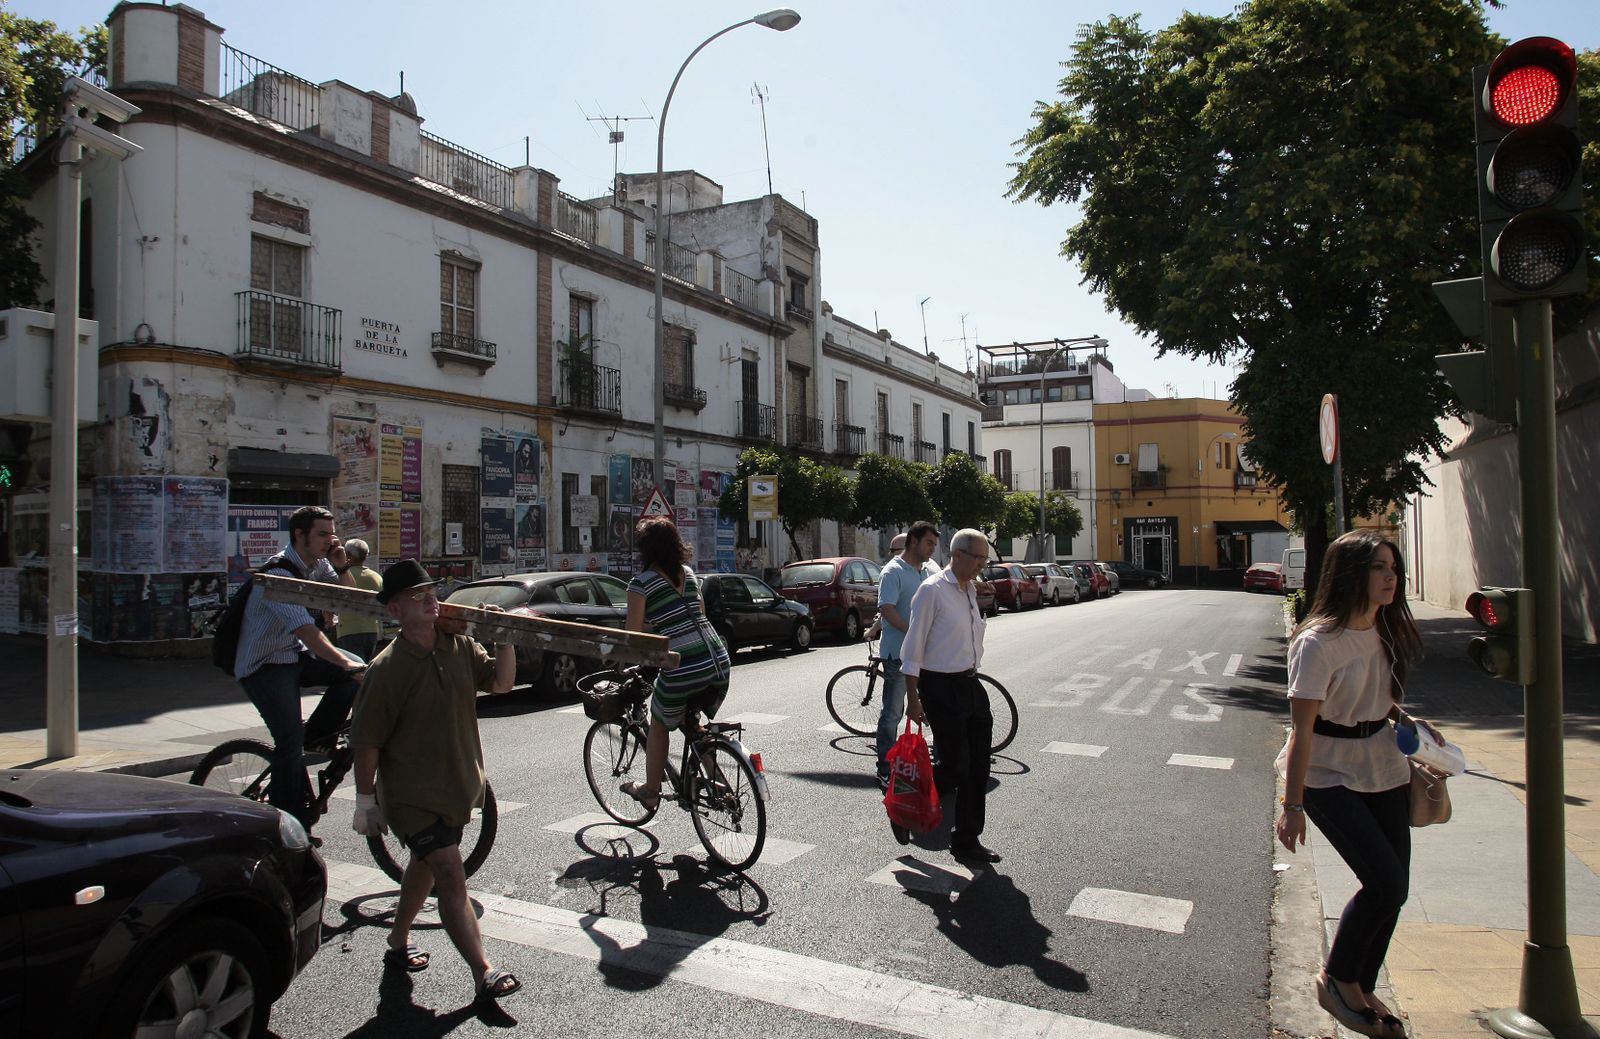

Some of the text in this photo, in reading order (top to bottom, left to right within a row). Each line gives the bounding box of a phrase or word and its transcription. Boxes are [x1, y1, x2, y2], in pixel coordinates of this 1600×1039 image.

[361, 317, 400, 333] PUERTA
[366, 330, 398, 344] DE LA
[355, 339, 408, 357] BARQUETA
[485, 465, 511, 474] FANGORIA
[254, 509, 278, 517] CULTURAL
[247, 518, 278, 529] FRANCÉS
[250, 532, 272, 540] CURSOS
[243, 547, 264, 555] VERANO
[1076, 644, 1243, 677] TAXI
[1028, 672, 1225, 722] BUS
